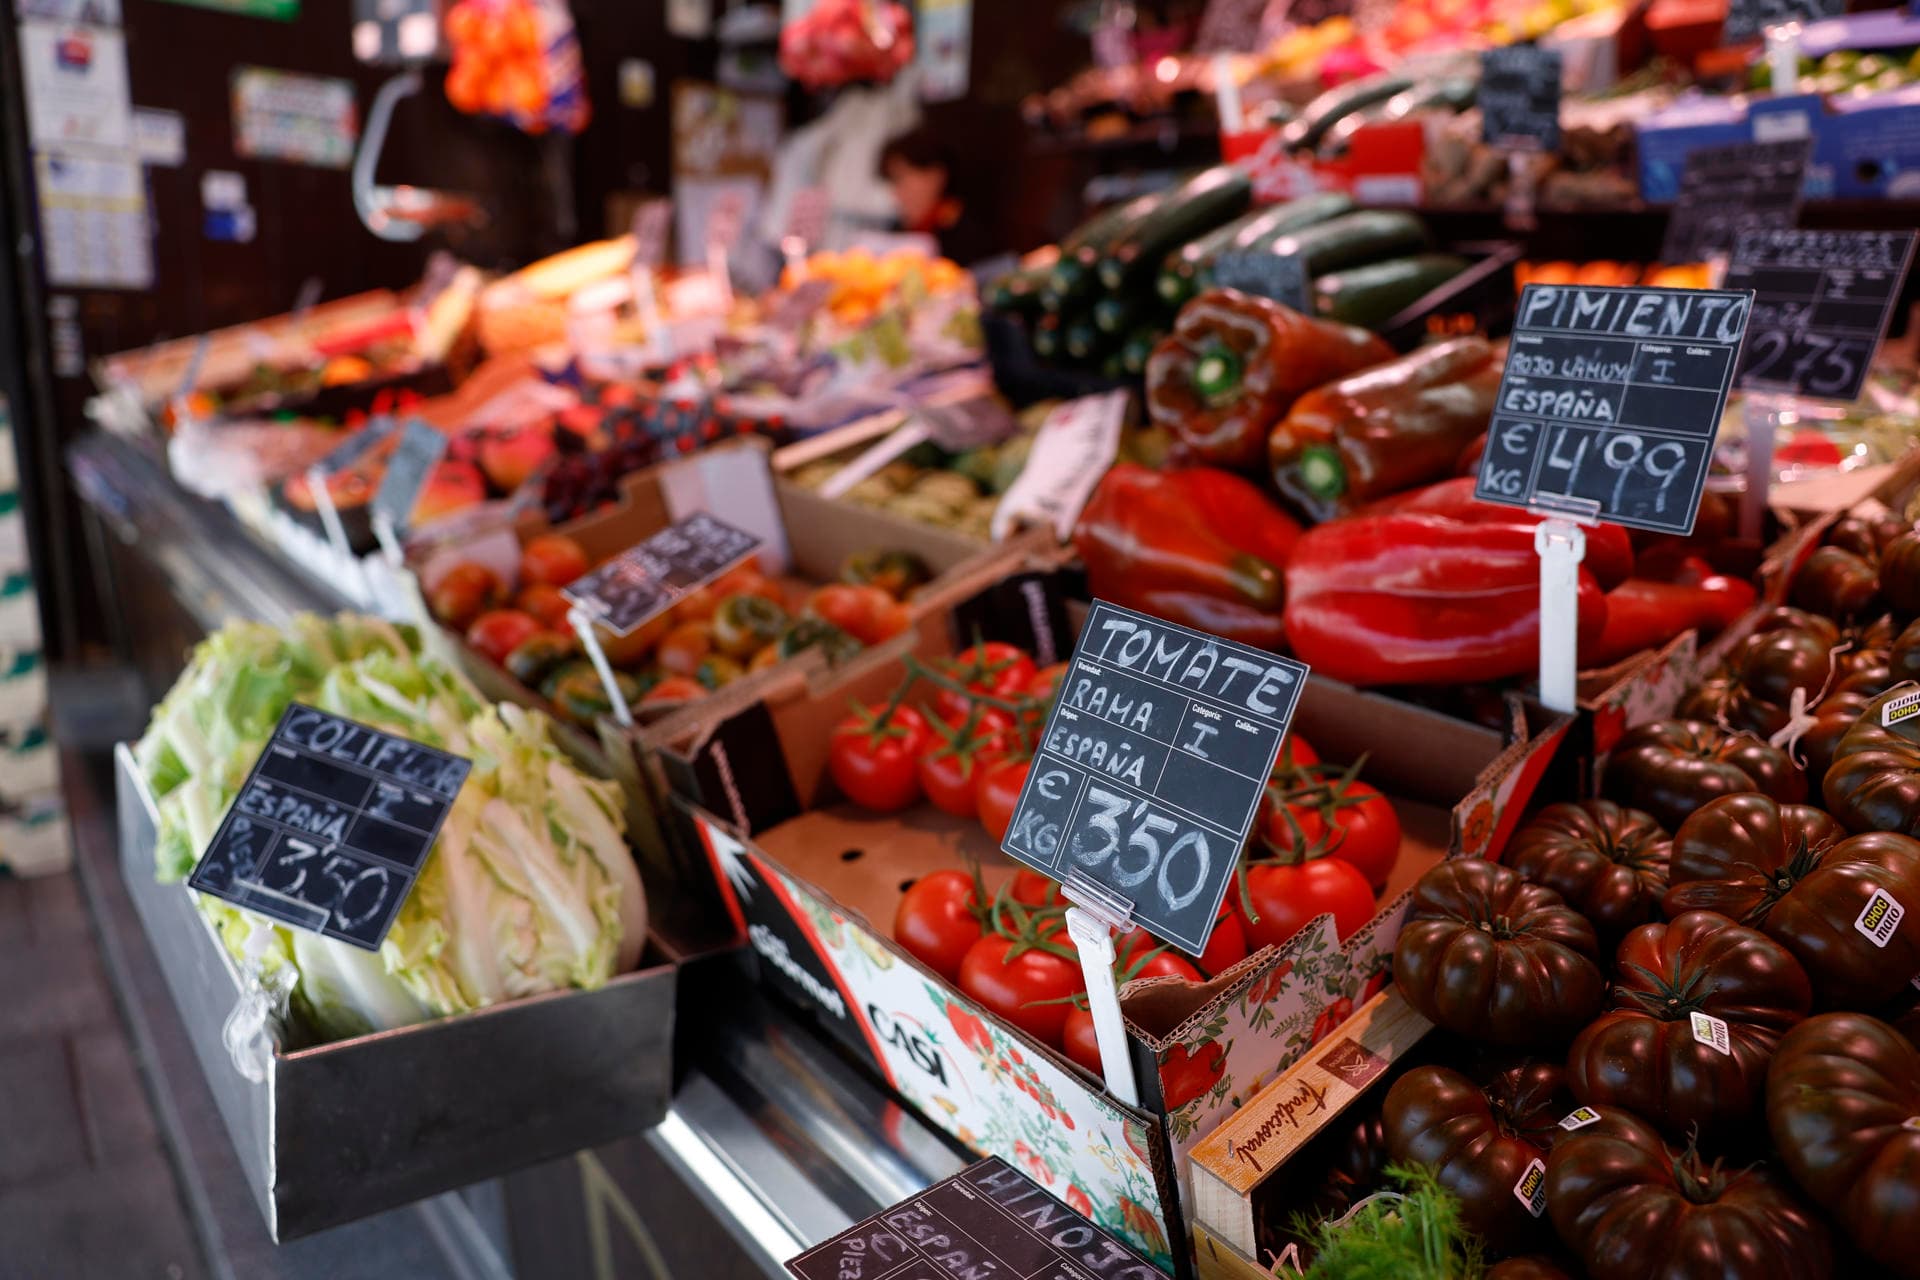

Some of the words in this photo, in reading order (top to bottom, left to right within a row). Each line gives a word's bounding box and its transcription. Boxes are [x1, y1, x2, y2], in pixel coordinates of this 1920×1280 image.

[1520, 287, 1751, 344] PIMIENTO
[1650, 359, 1677, 384] I
[1504, 389, 1614, 421] ESPAÑA
[1500, 423, 1534, 454] €
[1484, 462, 1522, 494] KG
[1097, 619, 1295, 715] TOMATE
[1069, 678, 1153, 733] RAMA
[1890, 703, 1919, 720] CHOC
[1048, 726, 1146, 787] ESPAÑA
[1183, 721, 1218, 758] I
[1037, 770, 1070, 800] €
[238, 786, 348, 846] ESPAÑA
[1013, 808, 1060, 855] KG
[1071, 786, 1211, 912] 3'50
[1863, 898, 1889, 929] CHOC
[1875, 907, 1901, 942] mato
[867, 1003, 949, 1088] CASI
[1521, 1168, 1542, 1198] CHOC
